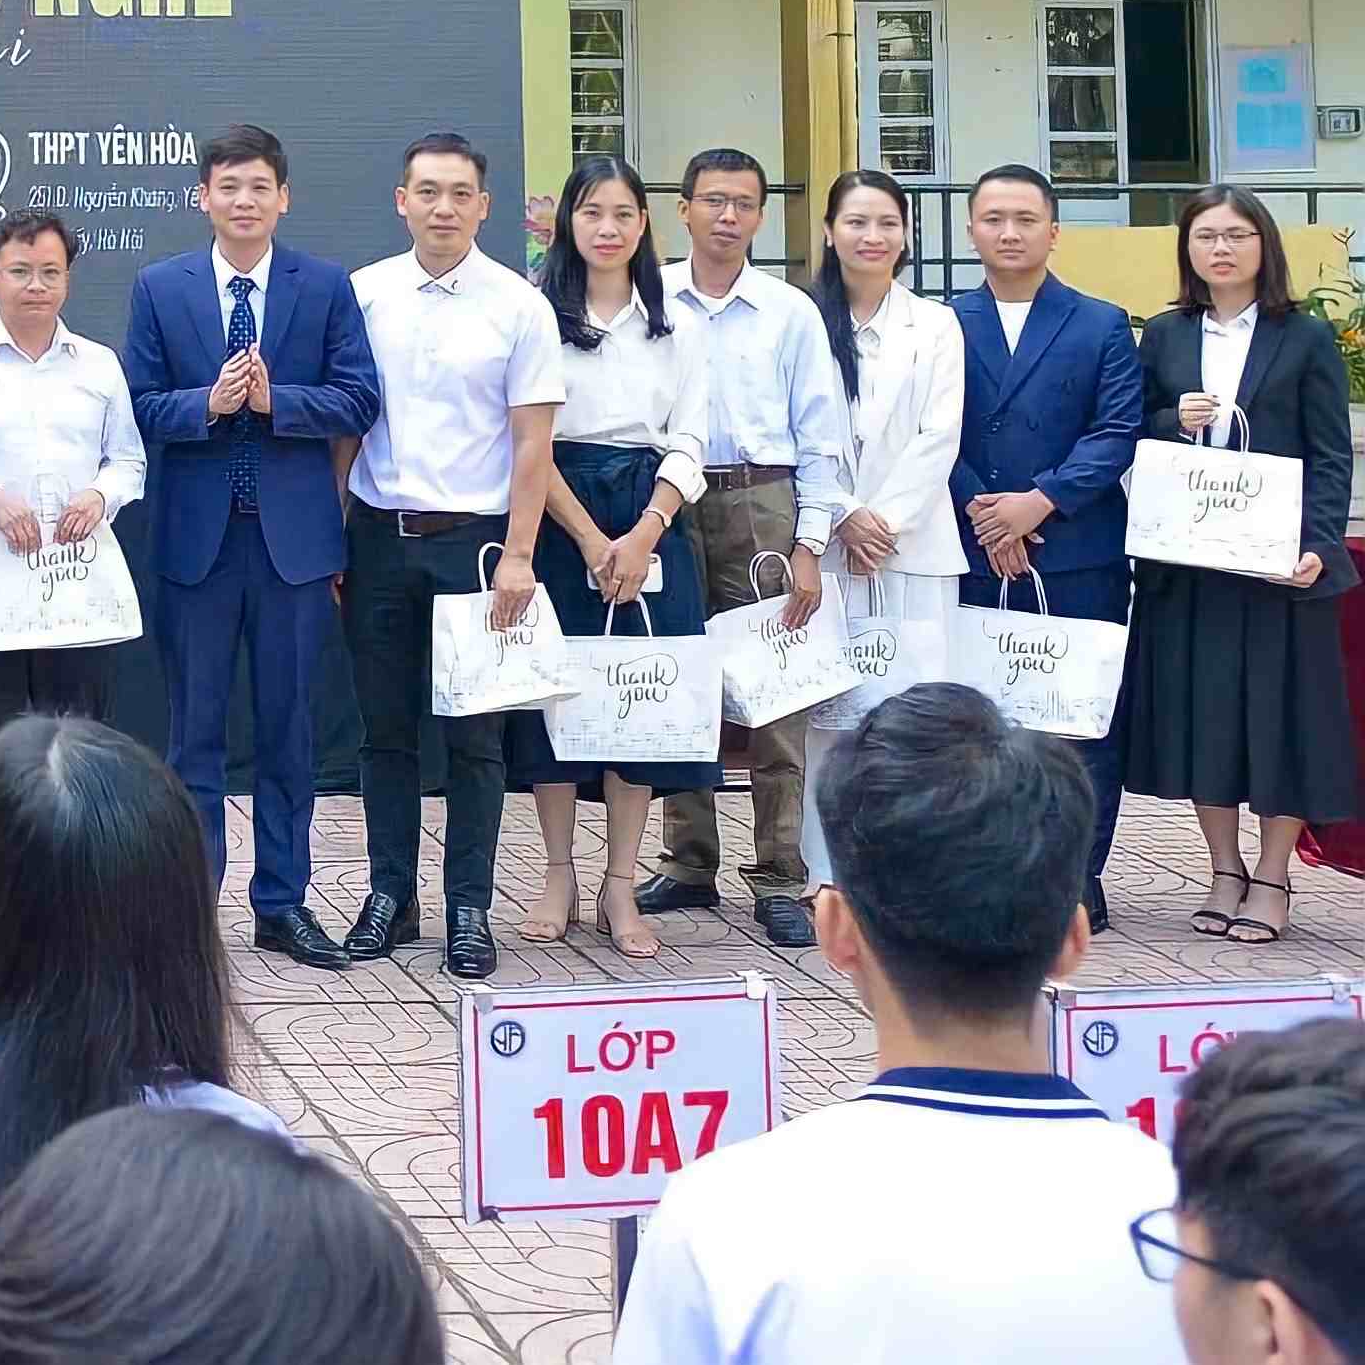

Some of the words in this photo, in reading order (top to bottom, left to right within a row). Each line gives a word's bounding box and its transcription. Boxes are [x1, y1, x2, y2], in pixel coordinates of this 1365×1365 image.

[29, 131, 90, 165] THPT
[95, 123, 144, 165] YÊN
[150, 123, 198, 165] HÒA
[999, 627, 1069, 659] thank
[607, 652, 679, 687] thank
[1007, 657, 1055, 685] you
[619, 685, 669, 720] you
[567, 1022, 676, 1073] LỚP
[1159, 1022, 1237, 1072] LỚ
[533, 1091, 729, 1179] 10A7
